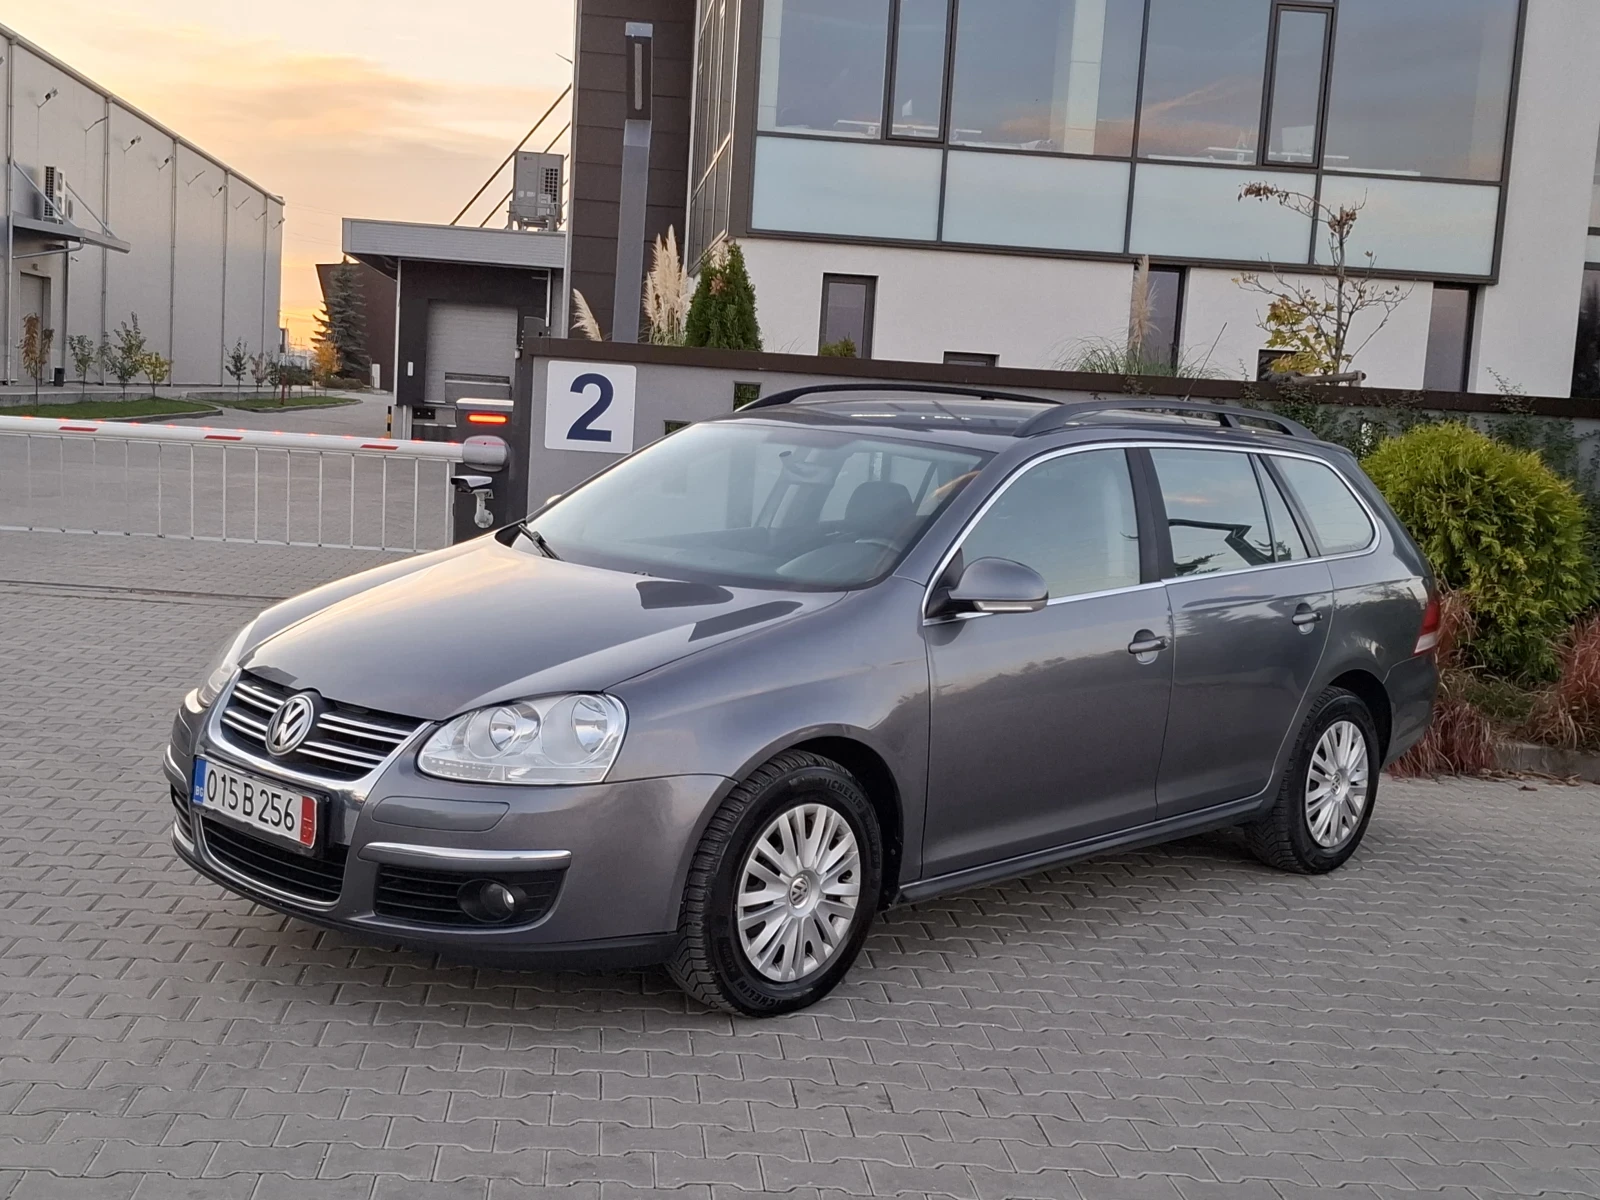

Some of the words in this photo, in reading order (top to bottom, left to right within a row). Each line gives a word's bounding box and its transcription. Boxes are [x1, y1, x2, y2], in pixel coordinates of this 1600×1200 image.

[566, 372, 614, 443] 2
[268, 695, 311, 752] VW
[195, 785, 204, 797] BG
